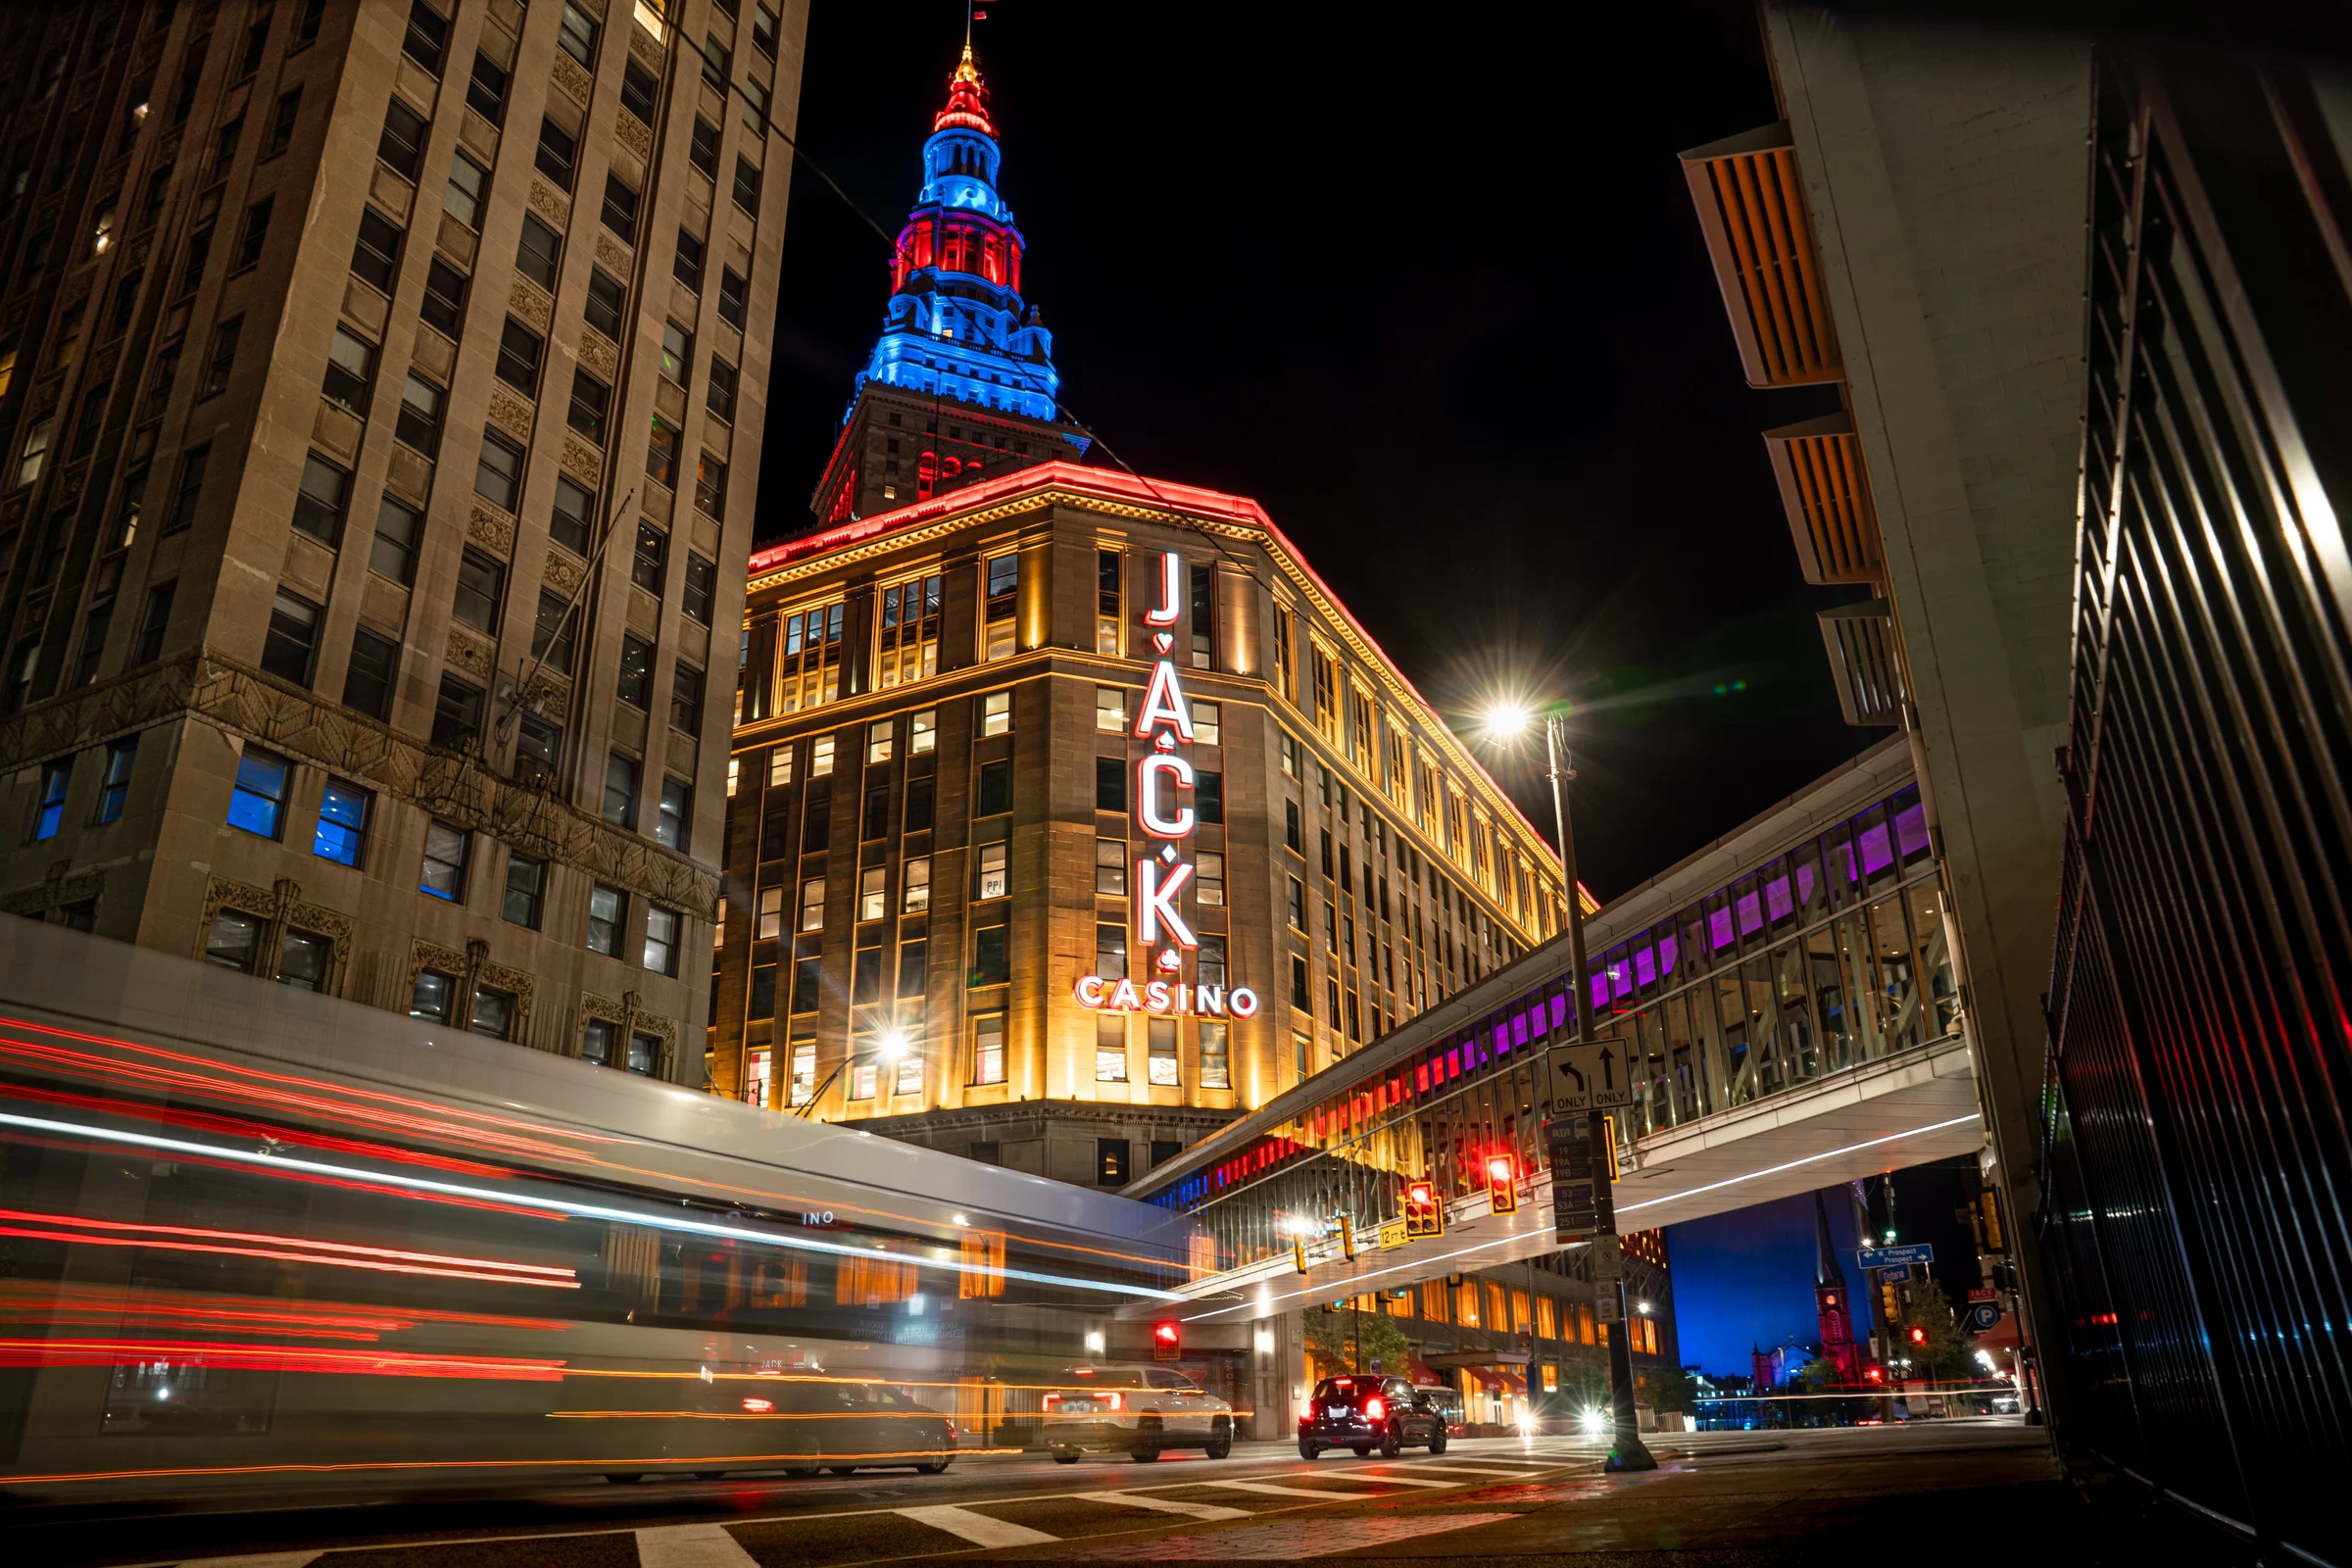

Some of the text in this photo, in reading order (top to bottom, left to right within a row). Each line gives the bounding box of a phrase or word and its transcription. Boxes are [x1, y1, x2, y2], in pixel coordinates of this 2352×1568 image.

[1135, 552, 1199, 951] JACK
[1074, 976, 1258, 1020] CASINO
[1557, 1091, 1625, 1109] ONLY ONLY
[1559, 1147, 1569, 1155] 19
[1554, 1157, 1571, 1167] 19A
[1555, 1168, 1572, 1178] 19B
[1561, 1189, 1573, 1199] 53
[1556, 1200, 1574, 1210] 53A
[1559, 1217, 1575, 1227] 251
[1382, 1231, 1390, 1245] 12
[1392, 1232, 1397, 1243] FT
[1887, 1247, 1917, 1255] Prospect
[1884, 1254, 1913, 1264] Prospect
[1599, 1284, 1609, 1293] NO
[1971, 1289, 1992, 1298] JACK
